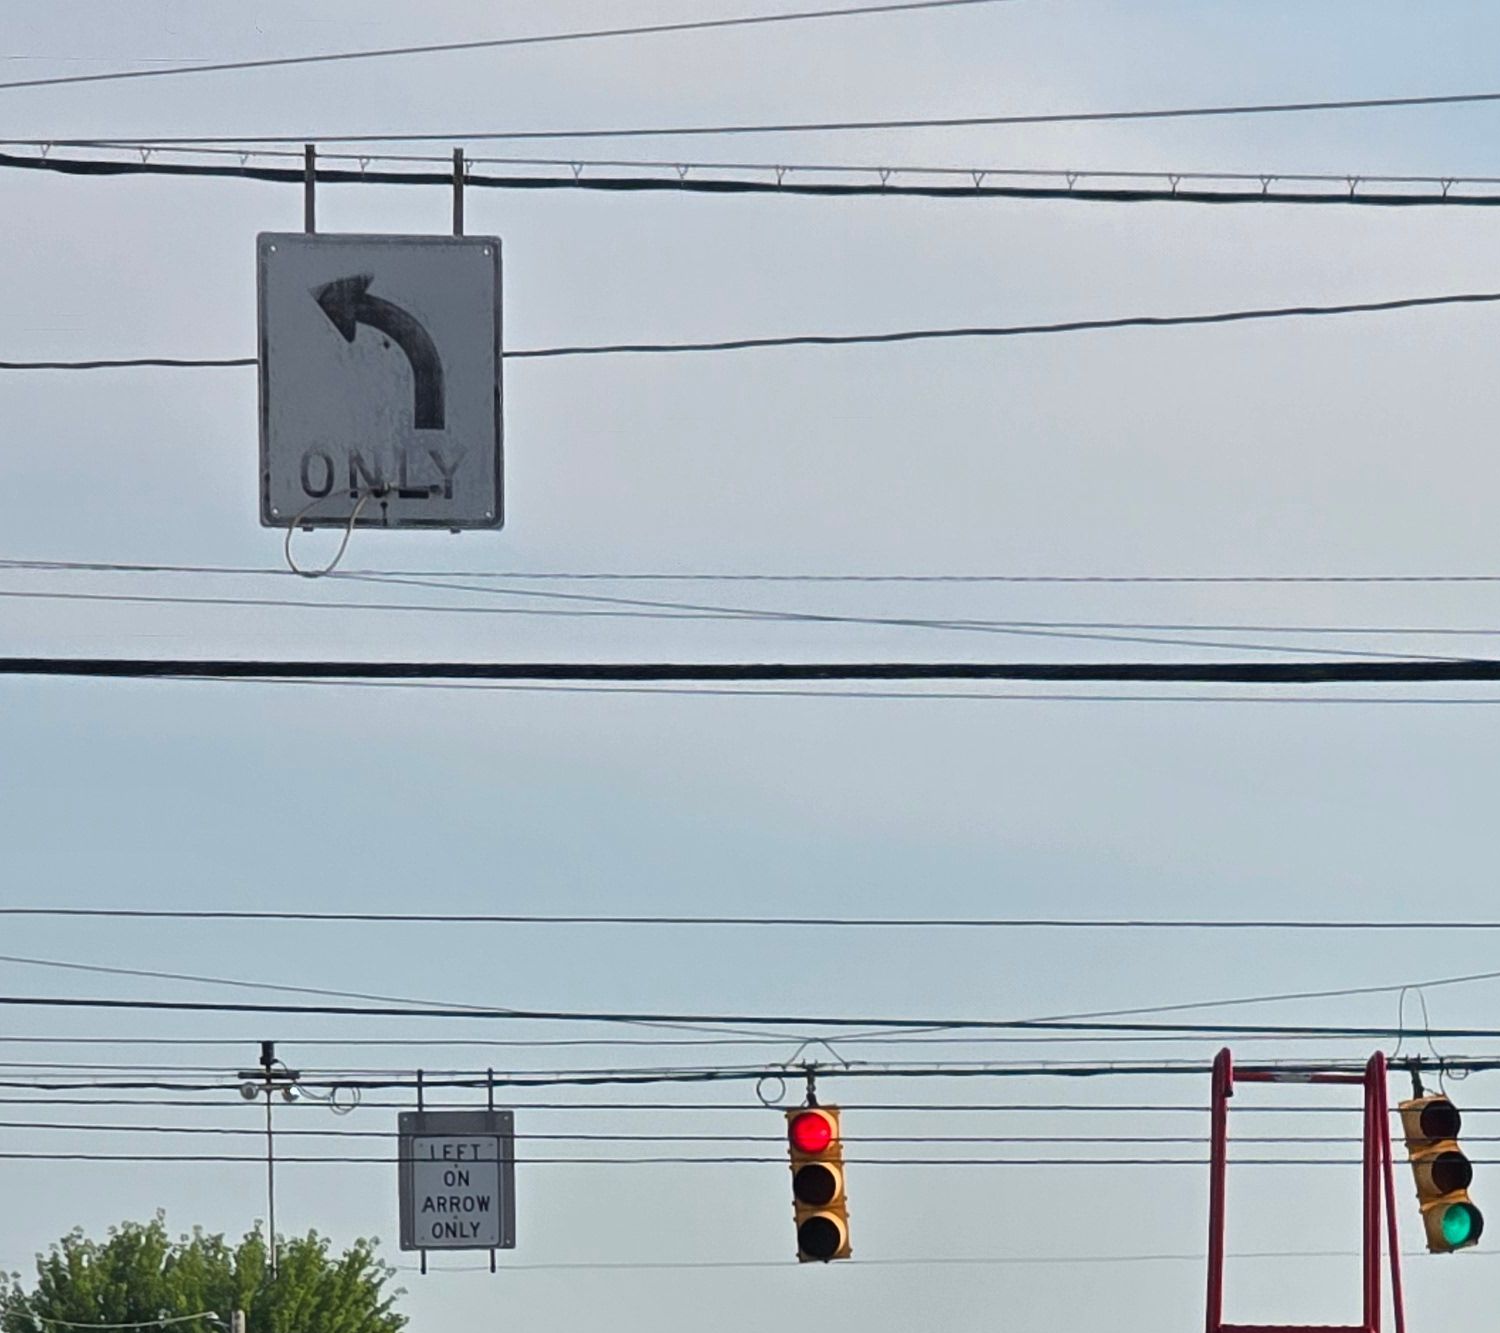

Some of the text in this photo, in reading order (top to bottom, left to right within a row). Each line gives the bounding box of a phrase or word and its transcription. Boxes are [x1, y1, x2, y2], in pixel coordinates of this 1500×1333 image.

[300, 446, 468, 500] ONLY
[430, 1143, 481, 1161] LEFT
[443, 1170, 470, 1187] ON
[421, 1195, 490, 1213] ARROW
[431, 1222, 481, 1239] ONLY
